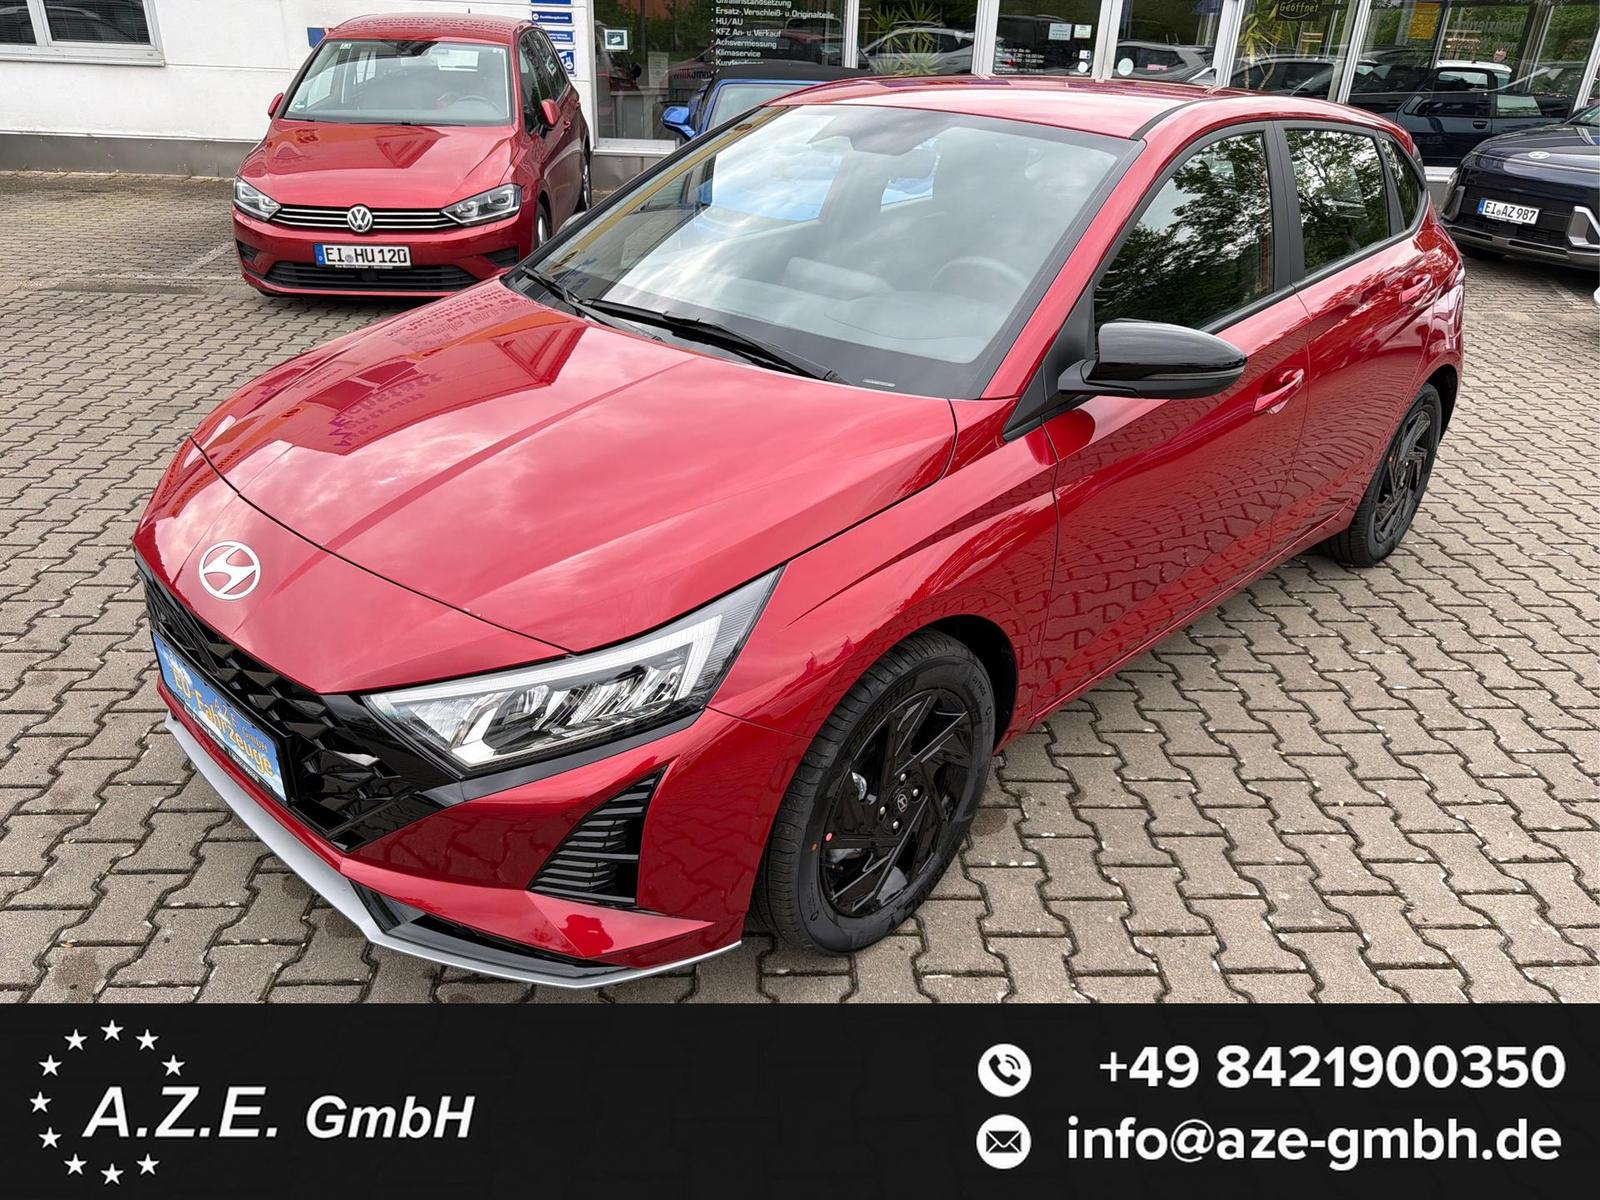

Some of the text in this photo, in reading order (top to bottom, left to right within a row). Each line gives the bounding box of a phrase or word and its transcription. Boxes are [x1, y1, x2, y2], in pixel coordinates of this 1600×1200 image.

[1280, 2, 1318, 13] Geöffnet
[715, 28, 730, 36] KFZ
[753, 29, 781, 37] Verkauf
[715, 39, 777, 49] Achsvermessung
[715, 49, 761, 58] Klimaservice
[1484, 201, 1497, 215] EI
[1501, 205, 1516, 218] AZ
[1516, 208, 1537, 221] 987
[325, 247, 407, 263] EI HU 120
